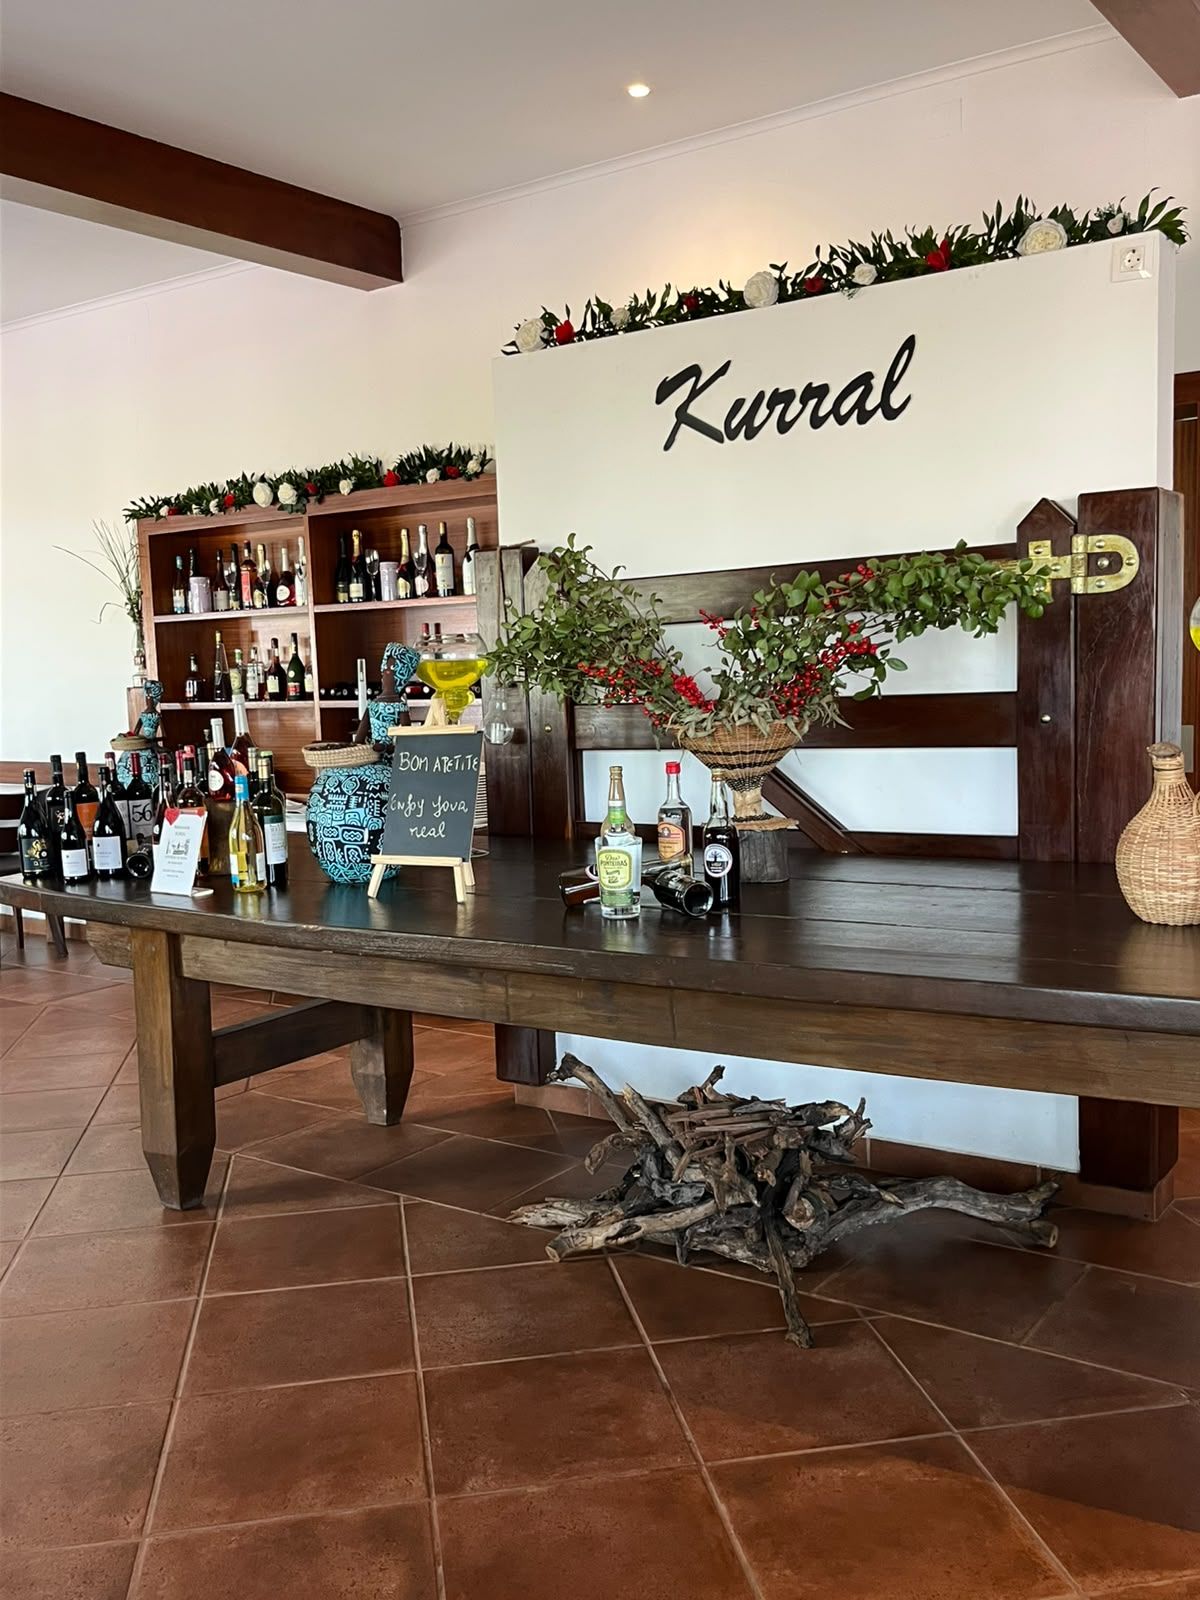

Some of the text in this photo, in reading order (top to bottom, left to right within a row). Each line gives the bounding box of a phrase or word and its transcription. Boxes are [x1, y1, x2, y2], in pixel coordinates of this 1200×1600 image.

[655, 334, 916, 452] Kurral
[399, 751, 479, 774] BOM APETITE
[131, 803, 153, 823] 56
